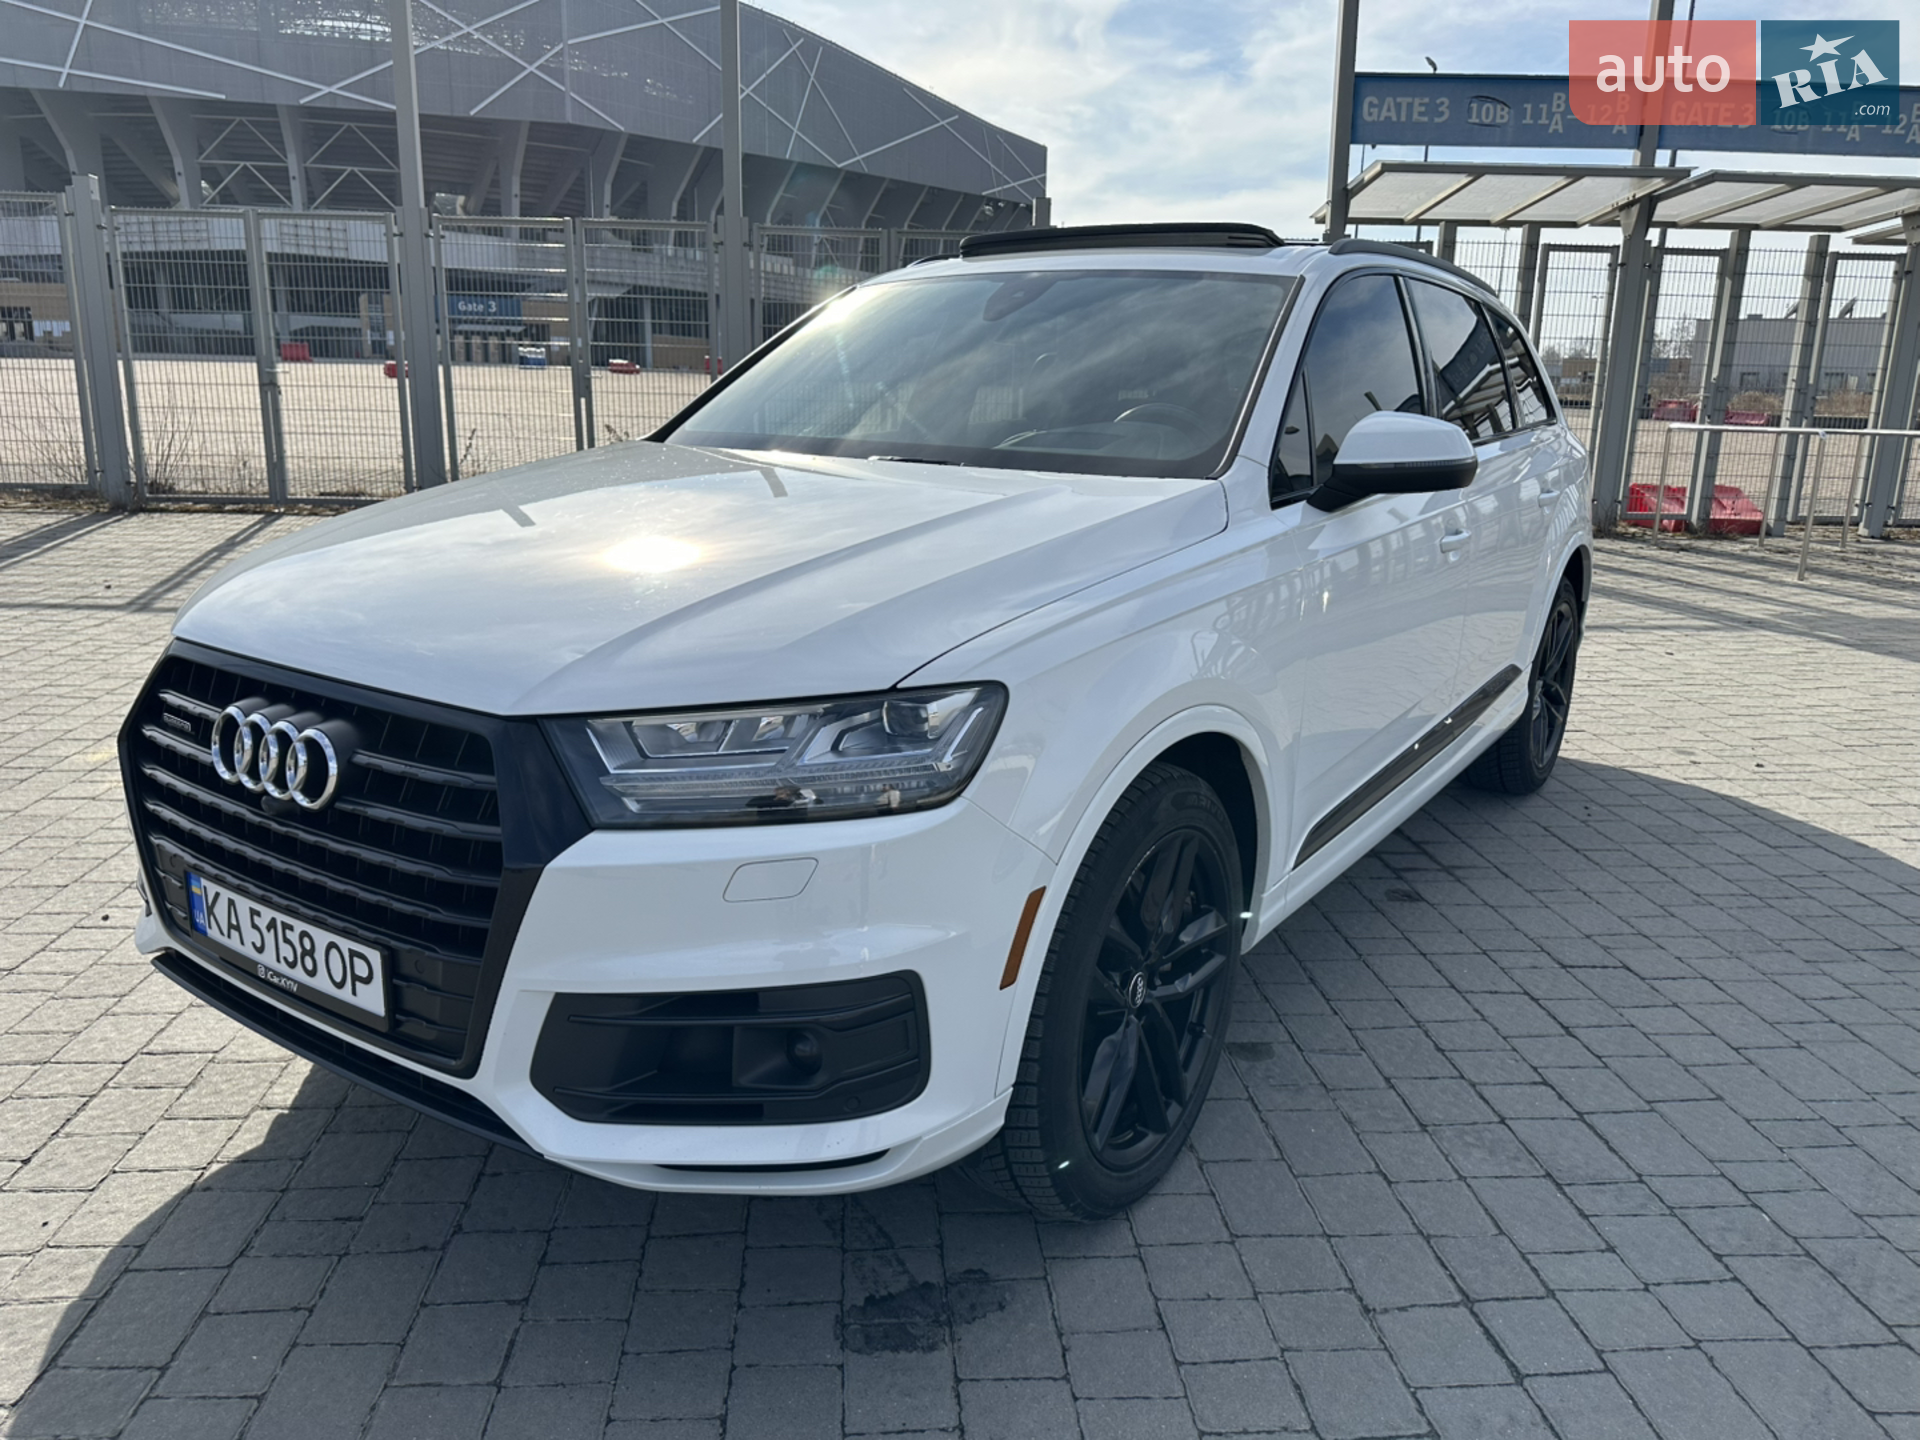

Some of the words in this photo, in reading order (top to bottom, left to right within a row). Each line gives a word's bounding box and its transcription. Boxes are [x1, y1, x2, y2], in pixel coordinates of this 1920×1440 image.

[1362, 96, 1430, 123] GATE
[1434, 97, 1450, 123] 3
[1468, 103, 1510, 125] 10B
[1669, 101, 1736, 129] GATE
[458, 300, 485, 313] Gate
[488, 300, 497, 313] 3
[193, 909, 206, 926] UA
[203, 884, 246, 947] KA
[248, 906, 318, 979] 5158
[324, 940, 374, 997] OP
